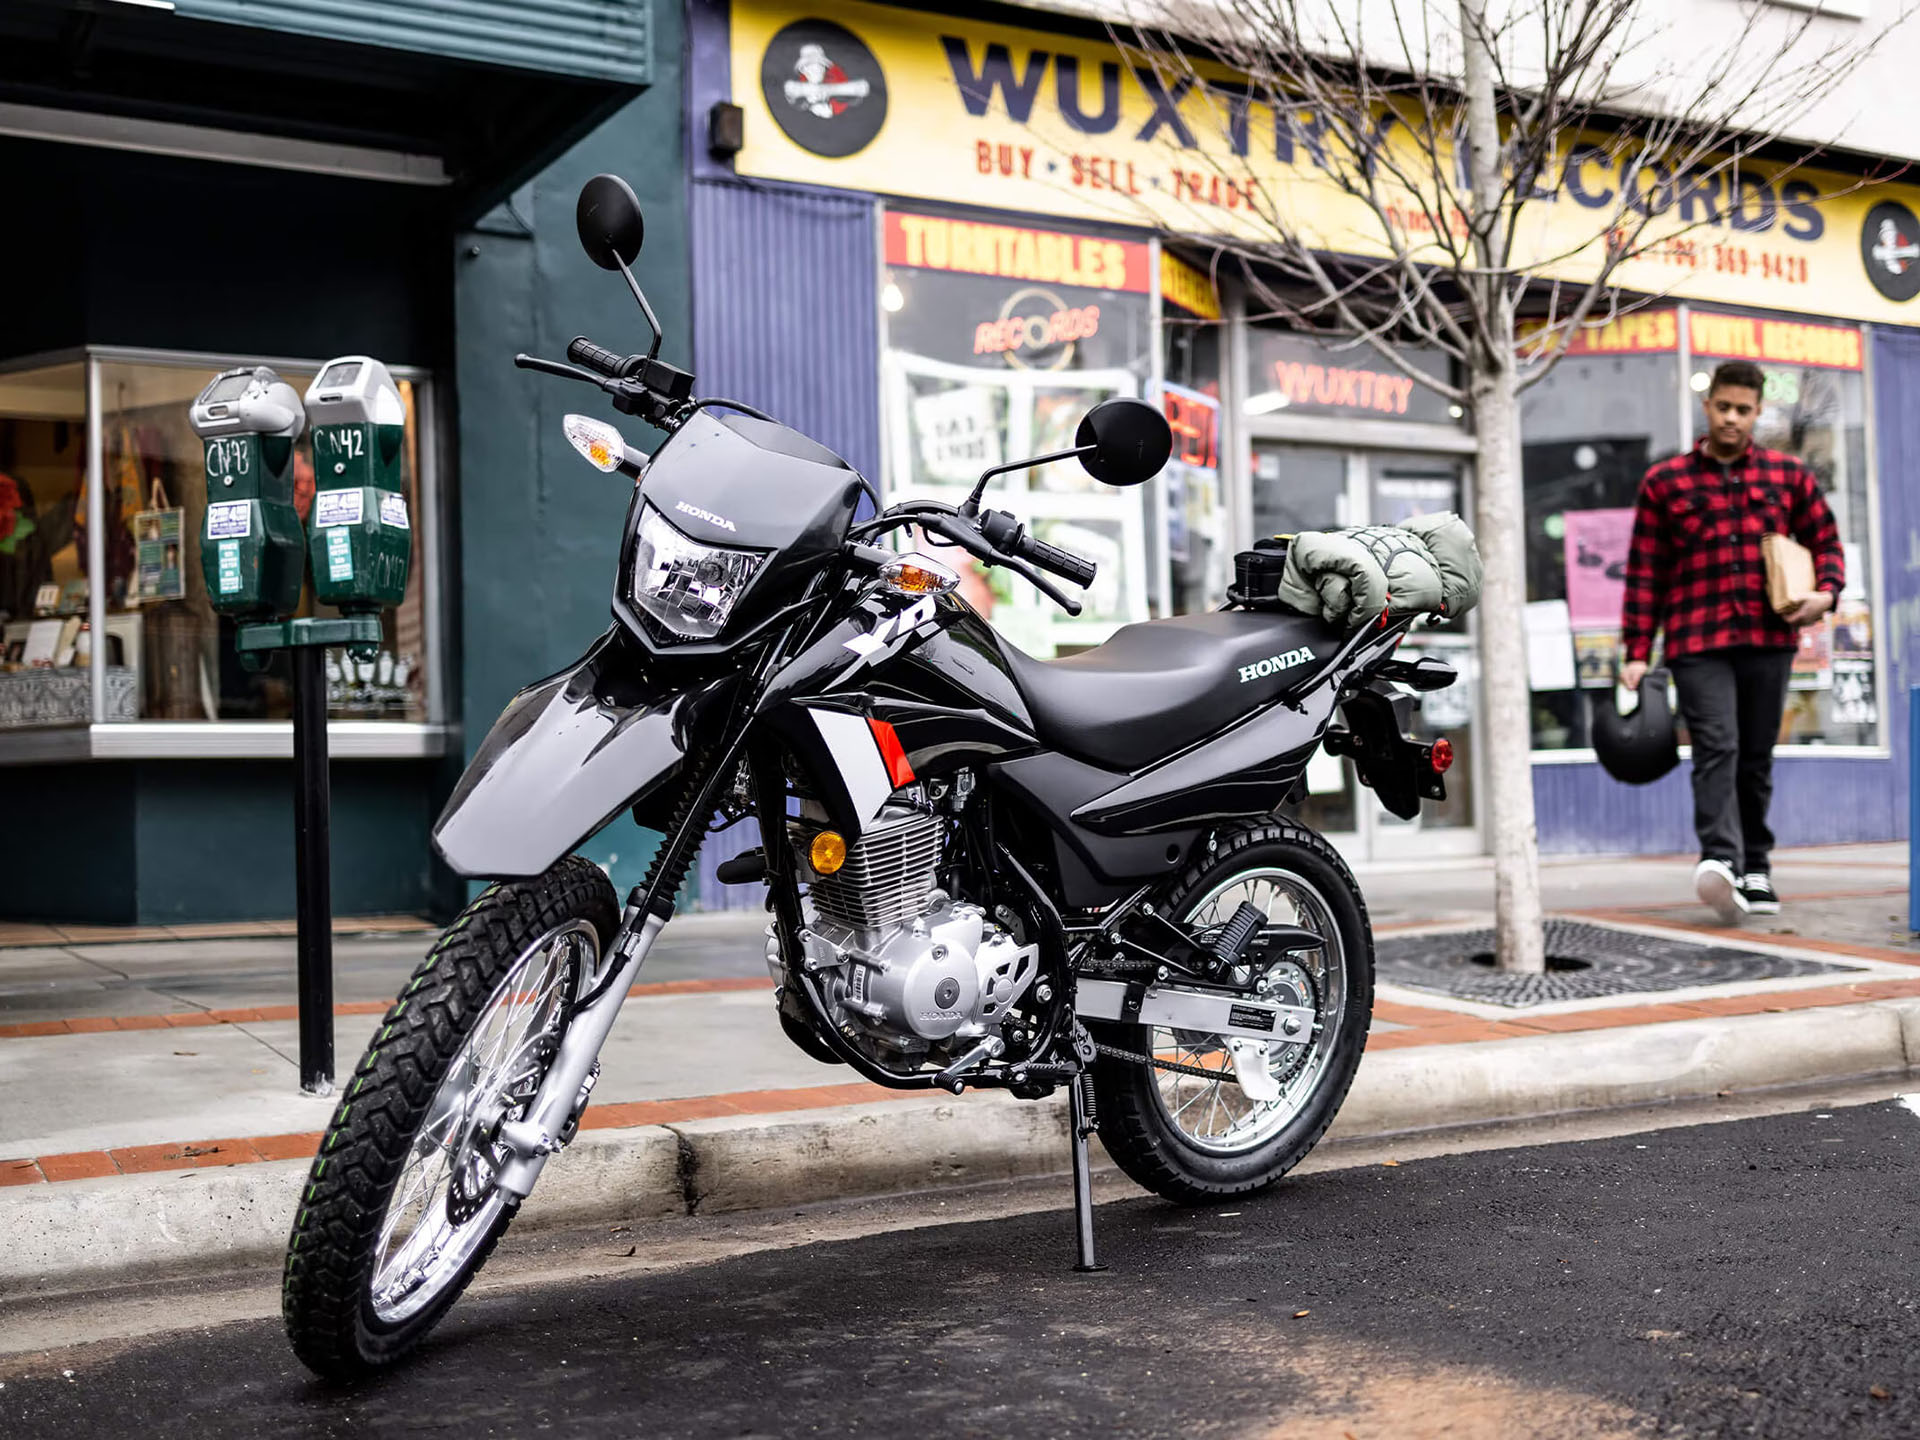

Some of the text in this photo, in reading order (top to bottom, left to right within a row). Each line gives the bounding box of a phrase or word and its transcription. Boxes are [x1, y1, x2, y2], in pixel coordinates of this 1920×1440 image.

[976, 140, 1258, 211] BUY SELL TRADE
[1456, 118, 1826, 242] ECORDS
[900, 215, 1126, 290] TURNTABLES
[973, 304, 1101, 355] RECORDS
[1690, 314, 1859, 368] VINYL RECORDS
[1275, 360, 1414, 415] WUXTRY
[313, 428, 364, 460] CN42
[674, 501, 736, 532] HONDA
[1238, 646, 1316, 683] HONDA
[919, 1010, 964, 1021] HONDA
